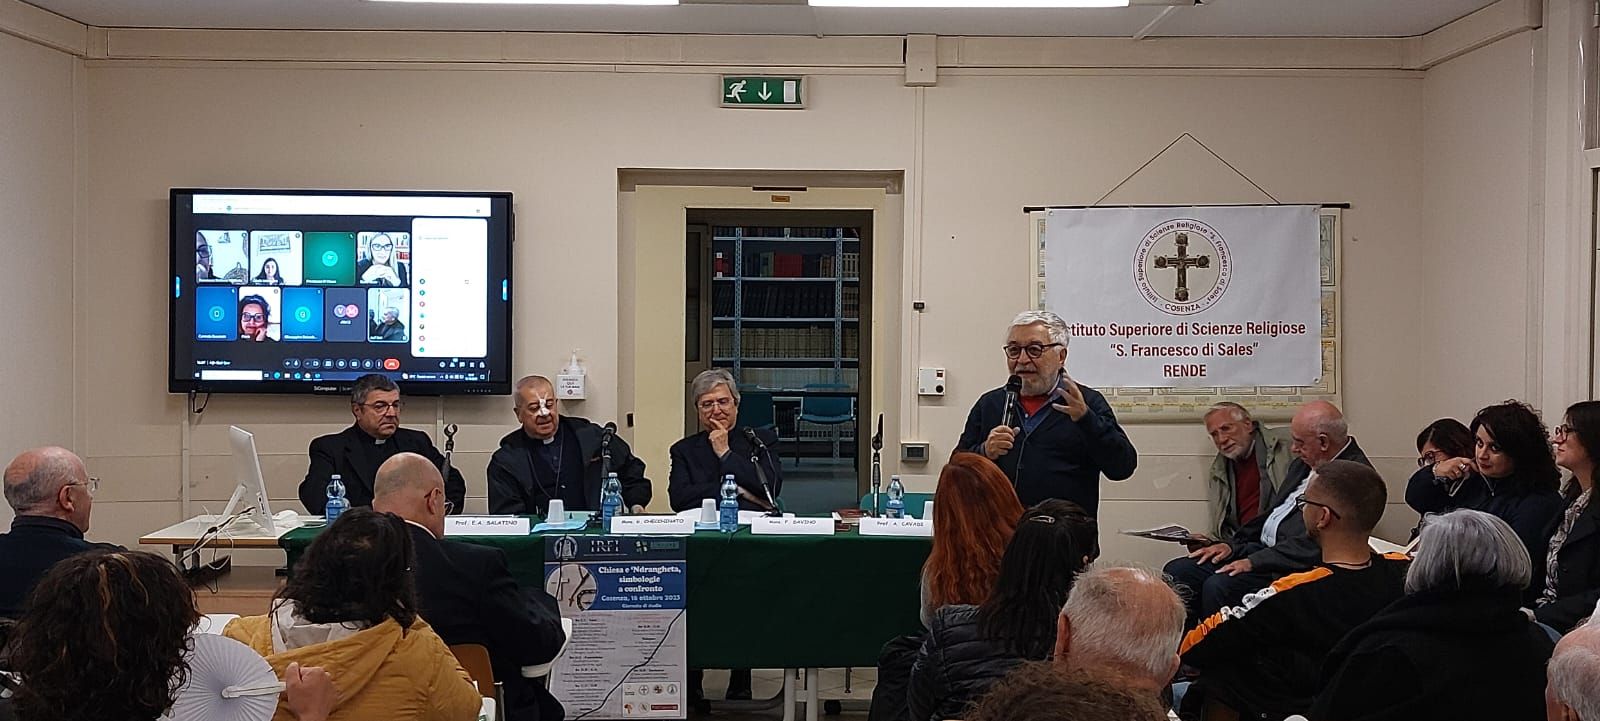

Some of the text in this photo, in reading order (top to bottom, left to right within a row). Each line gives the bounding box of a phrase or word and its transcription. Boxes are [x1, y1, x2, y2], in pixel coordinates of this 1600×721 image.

[1137, 247, 1147, 281] Superiore
[1149, 224, 1175, 240] Scienze
[1176, 221, 1208, 234] Religiose
[1215, 240, 1228, 277] Francesco
[1164, 303, 1201, 313] COSENZA
[1067, 321, 1306, 339] tituto Superiore di Scienze Religiose
[1110, 341, 1259, 357] "S. Francesco di Sales"
[1163, 364, 1207, 378] RENDE
[598, 566, 624, 574] Chiesa
[624, 566, 630, 574] e
[618, 575, 661, 584] simbologie
[624, 585, 664, 593] confronto
